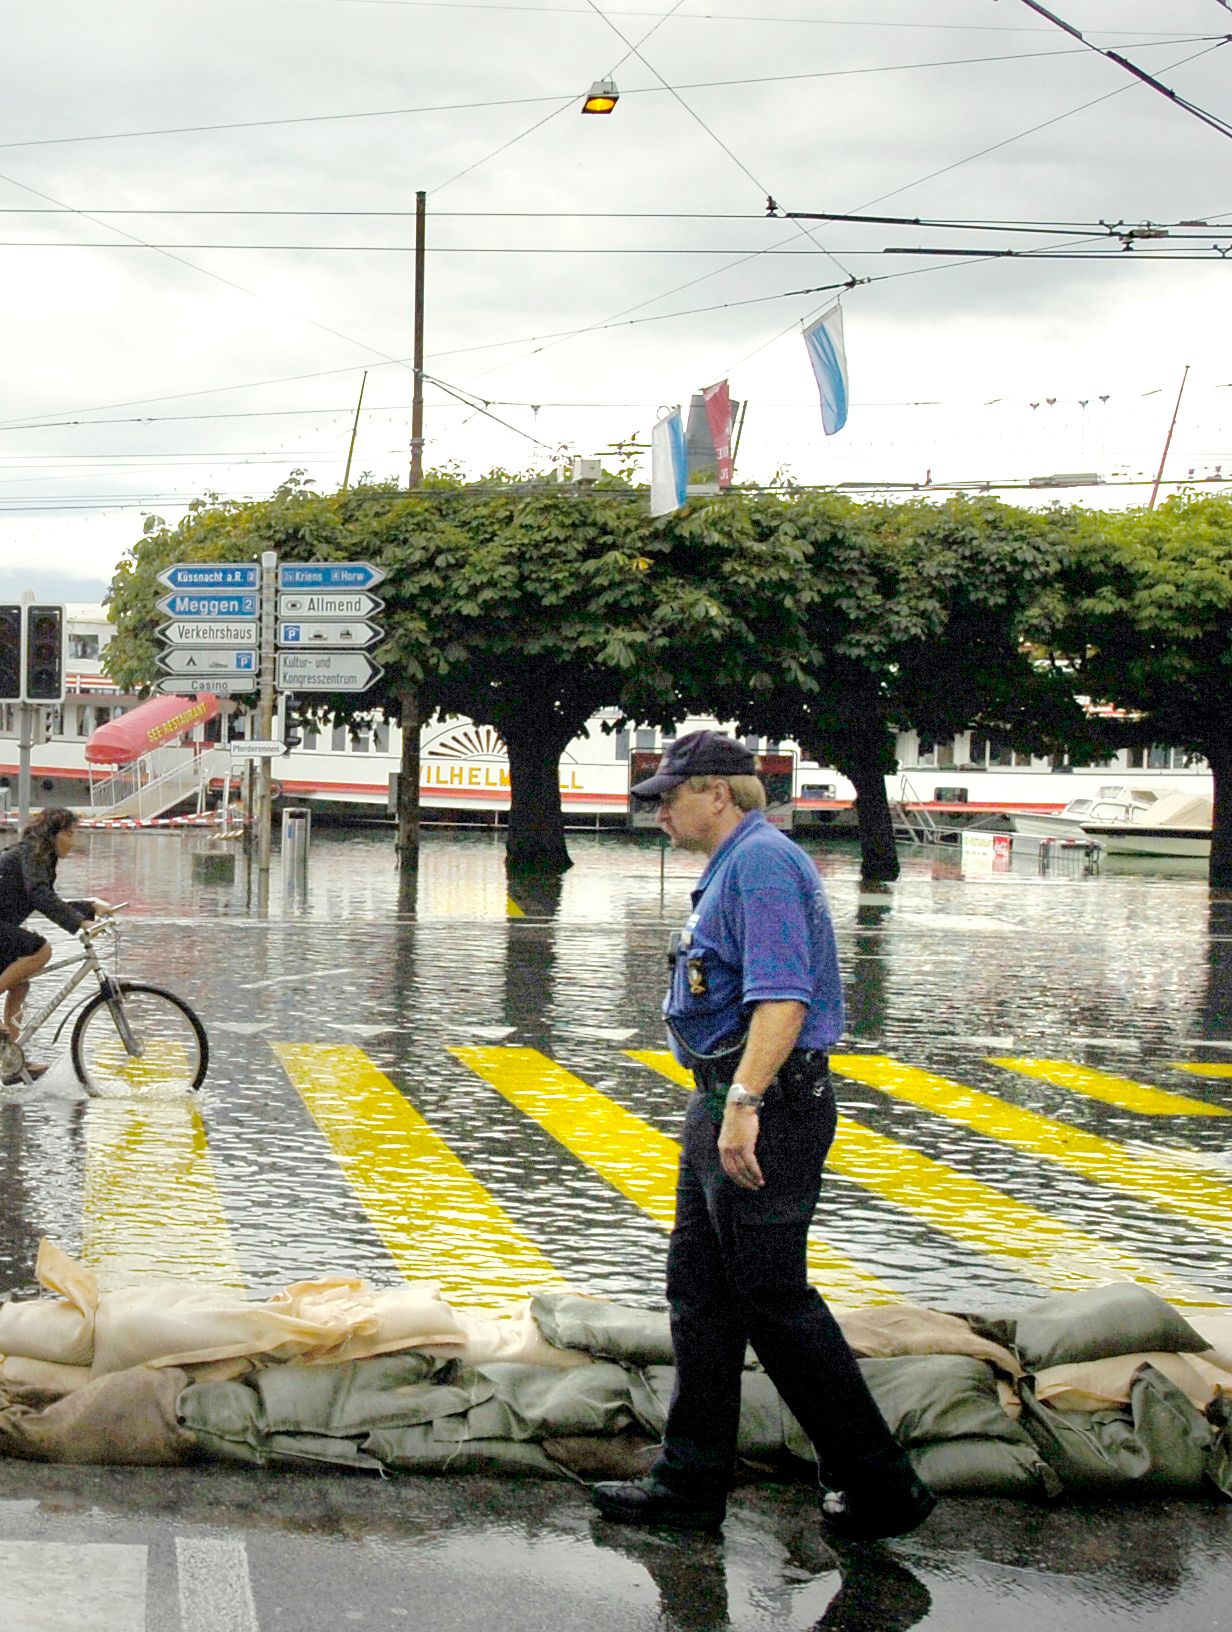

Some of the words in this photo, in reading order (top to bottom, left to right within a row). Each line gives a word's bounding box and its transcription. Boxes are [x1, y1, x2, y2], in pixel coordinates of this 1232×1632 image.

[295, 571, 323, 581] Kriens
[341, 571, 365, 581] Horw
[175, 597, 239, 615] Meggen
[244, 599, 253, 610] 2
[307, 597, 362, 612] Allmend
[177, 624, 252, 640] Verkehrshaus
[283, 656, 312, 669] Kultur-
[315, 656, 331, 669] und
[191, 680, 228, 691] Casino
[283, 672, 358, 687] Kongresszentrum
[420, 765, 511, 787] ILHELM
